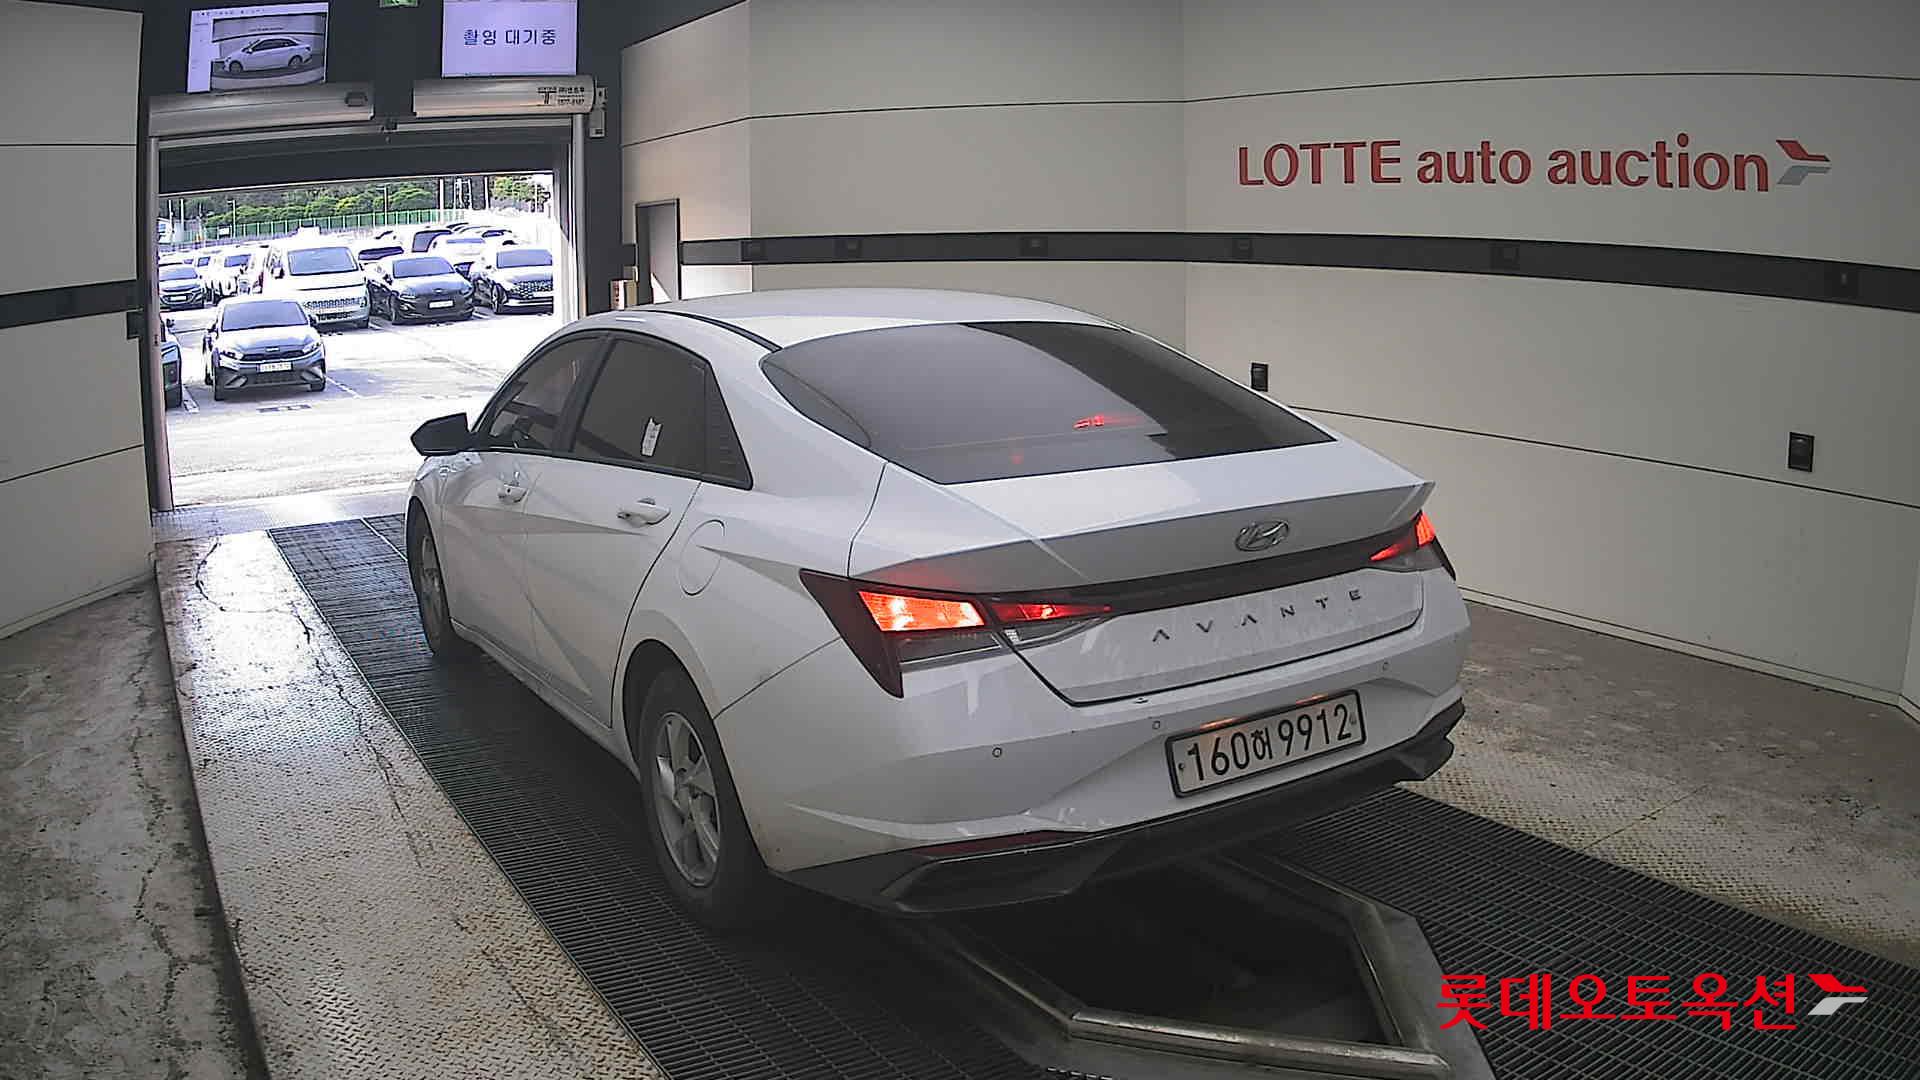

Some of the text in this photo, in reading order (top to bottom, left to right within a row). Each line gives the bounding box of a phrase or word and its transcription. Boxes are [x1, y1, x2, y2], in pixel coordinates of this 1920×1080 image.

[505, 28, 556, 45] 대기중
[1238, 132, 1769, 192] LOTTE auto auction
[1152, 589, 1361, 642] AVANTE
